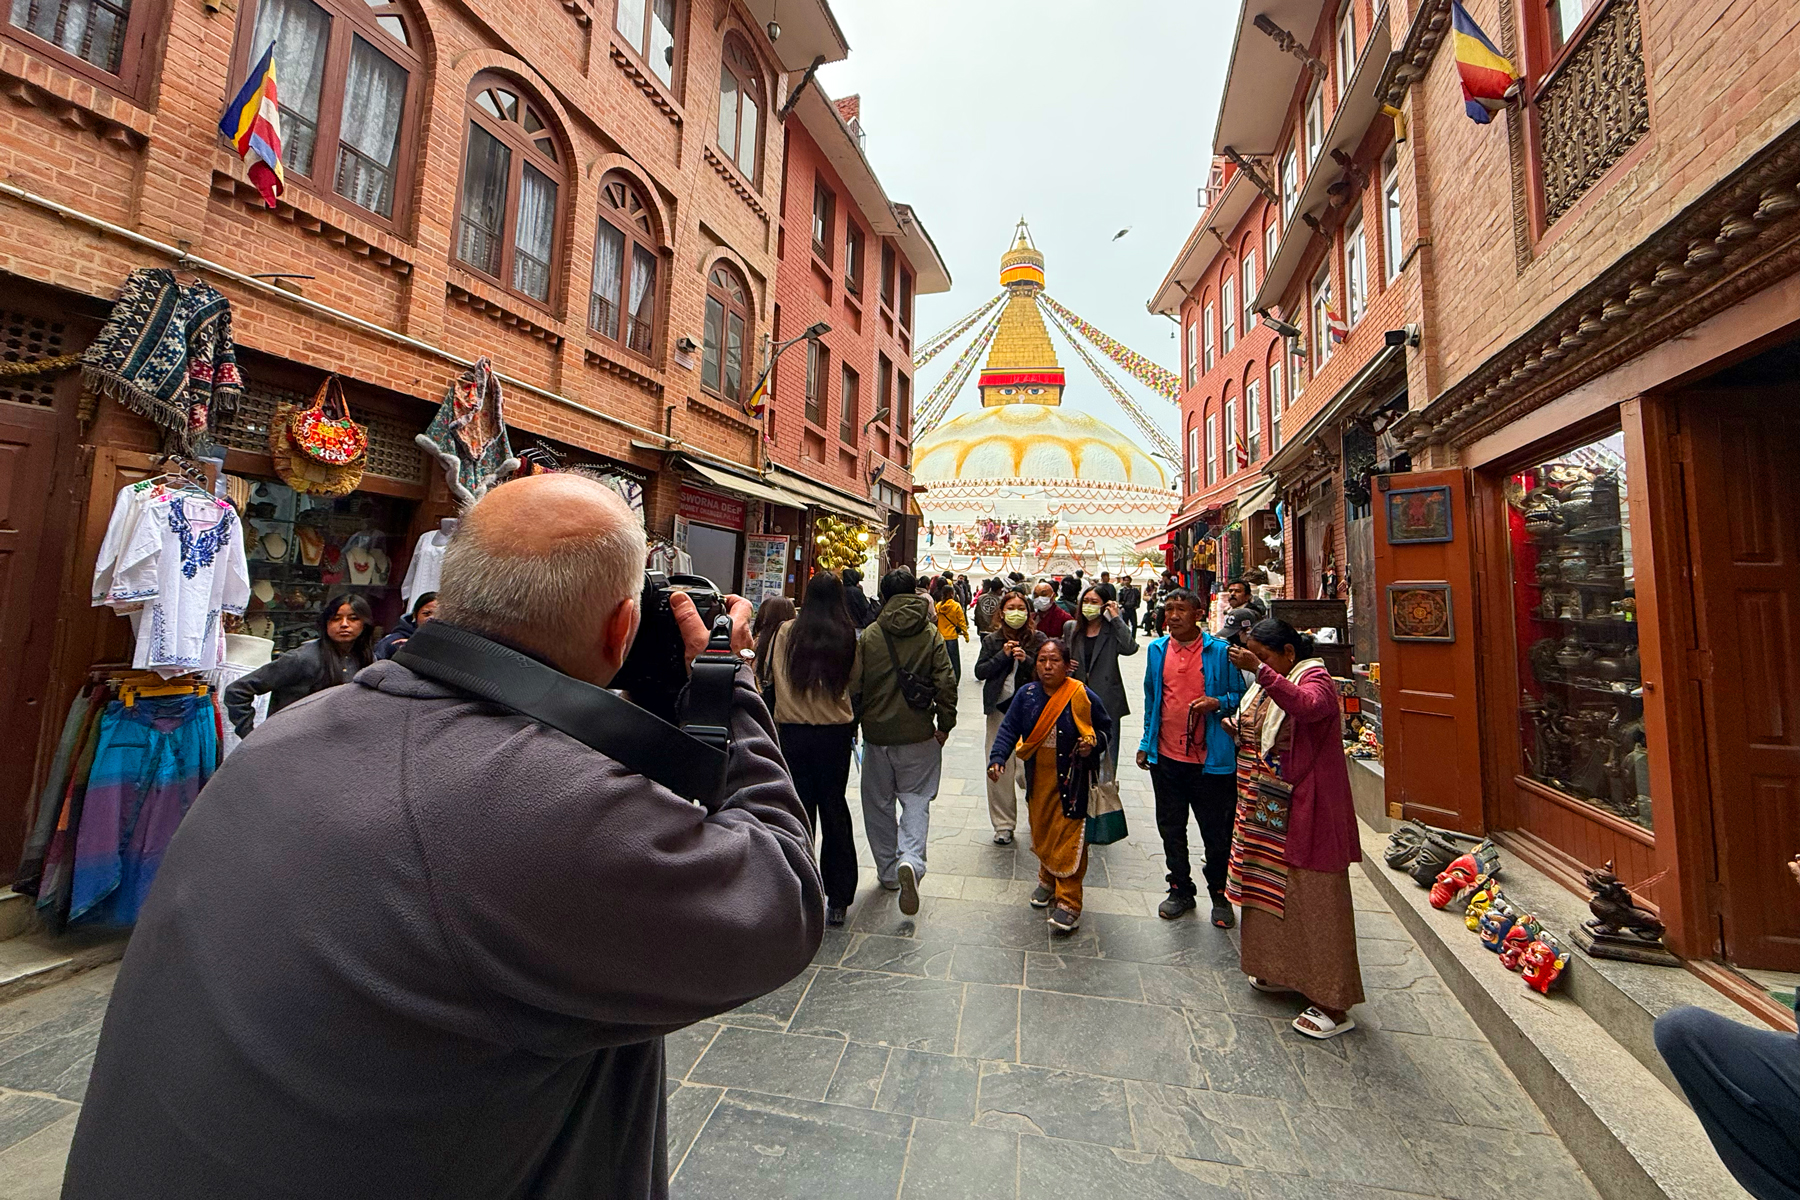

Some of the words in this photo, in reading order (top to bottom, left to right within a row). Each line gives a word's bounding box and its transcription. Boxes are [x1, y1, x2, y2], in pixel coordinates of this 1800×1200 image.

[680, 491, 719, 510] SWORNA
[721, 502, 743, 515] DEEP
[680, 502, 700, 513] MONEY
